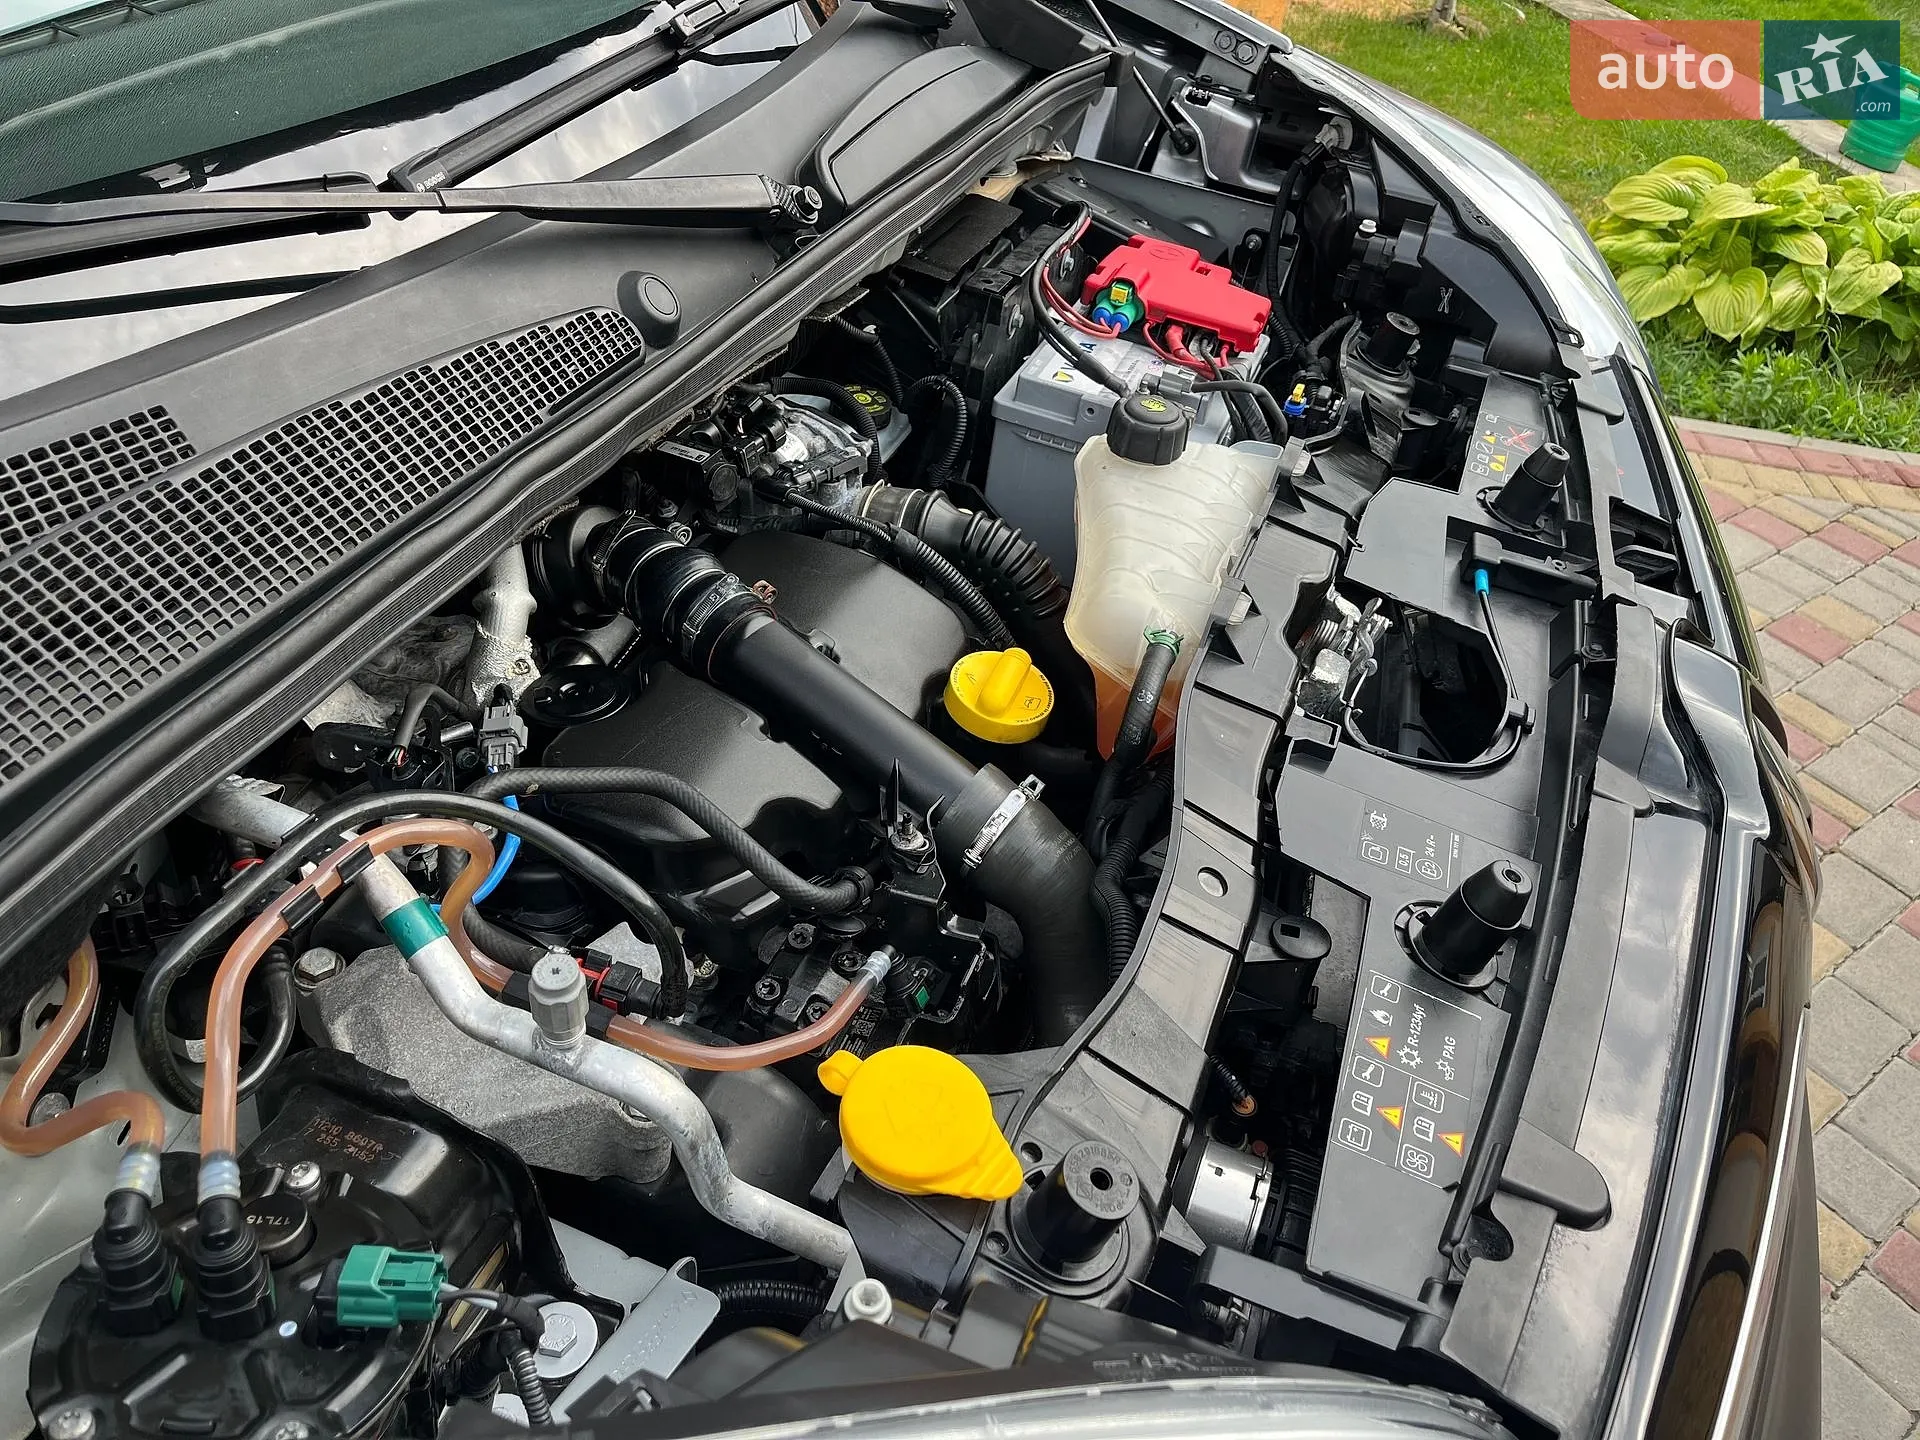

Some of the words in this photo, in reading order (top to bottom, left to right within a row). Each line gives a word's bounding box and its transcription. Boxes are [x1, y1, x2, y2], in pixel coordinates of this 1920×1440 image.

[1421, 861, 1437, 877] E2
[1407, 1003, 1427, 1047] R-1234yf
[1442, 1036, 1456, 1060] PAG
